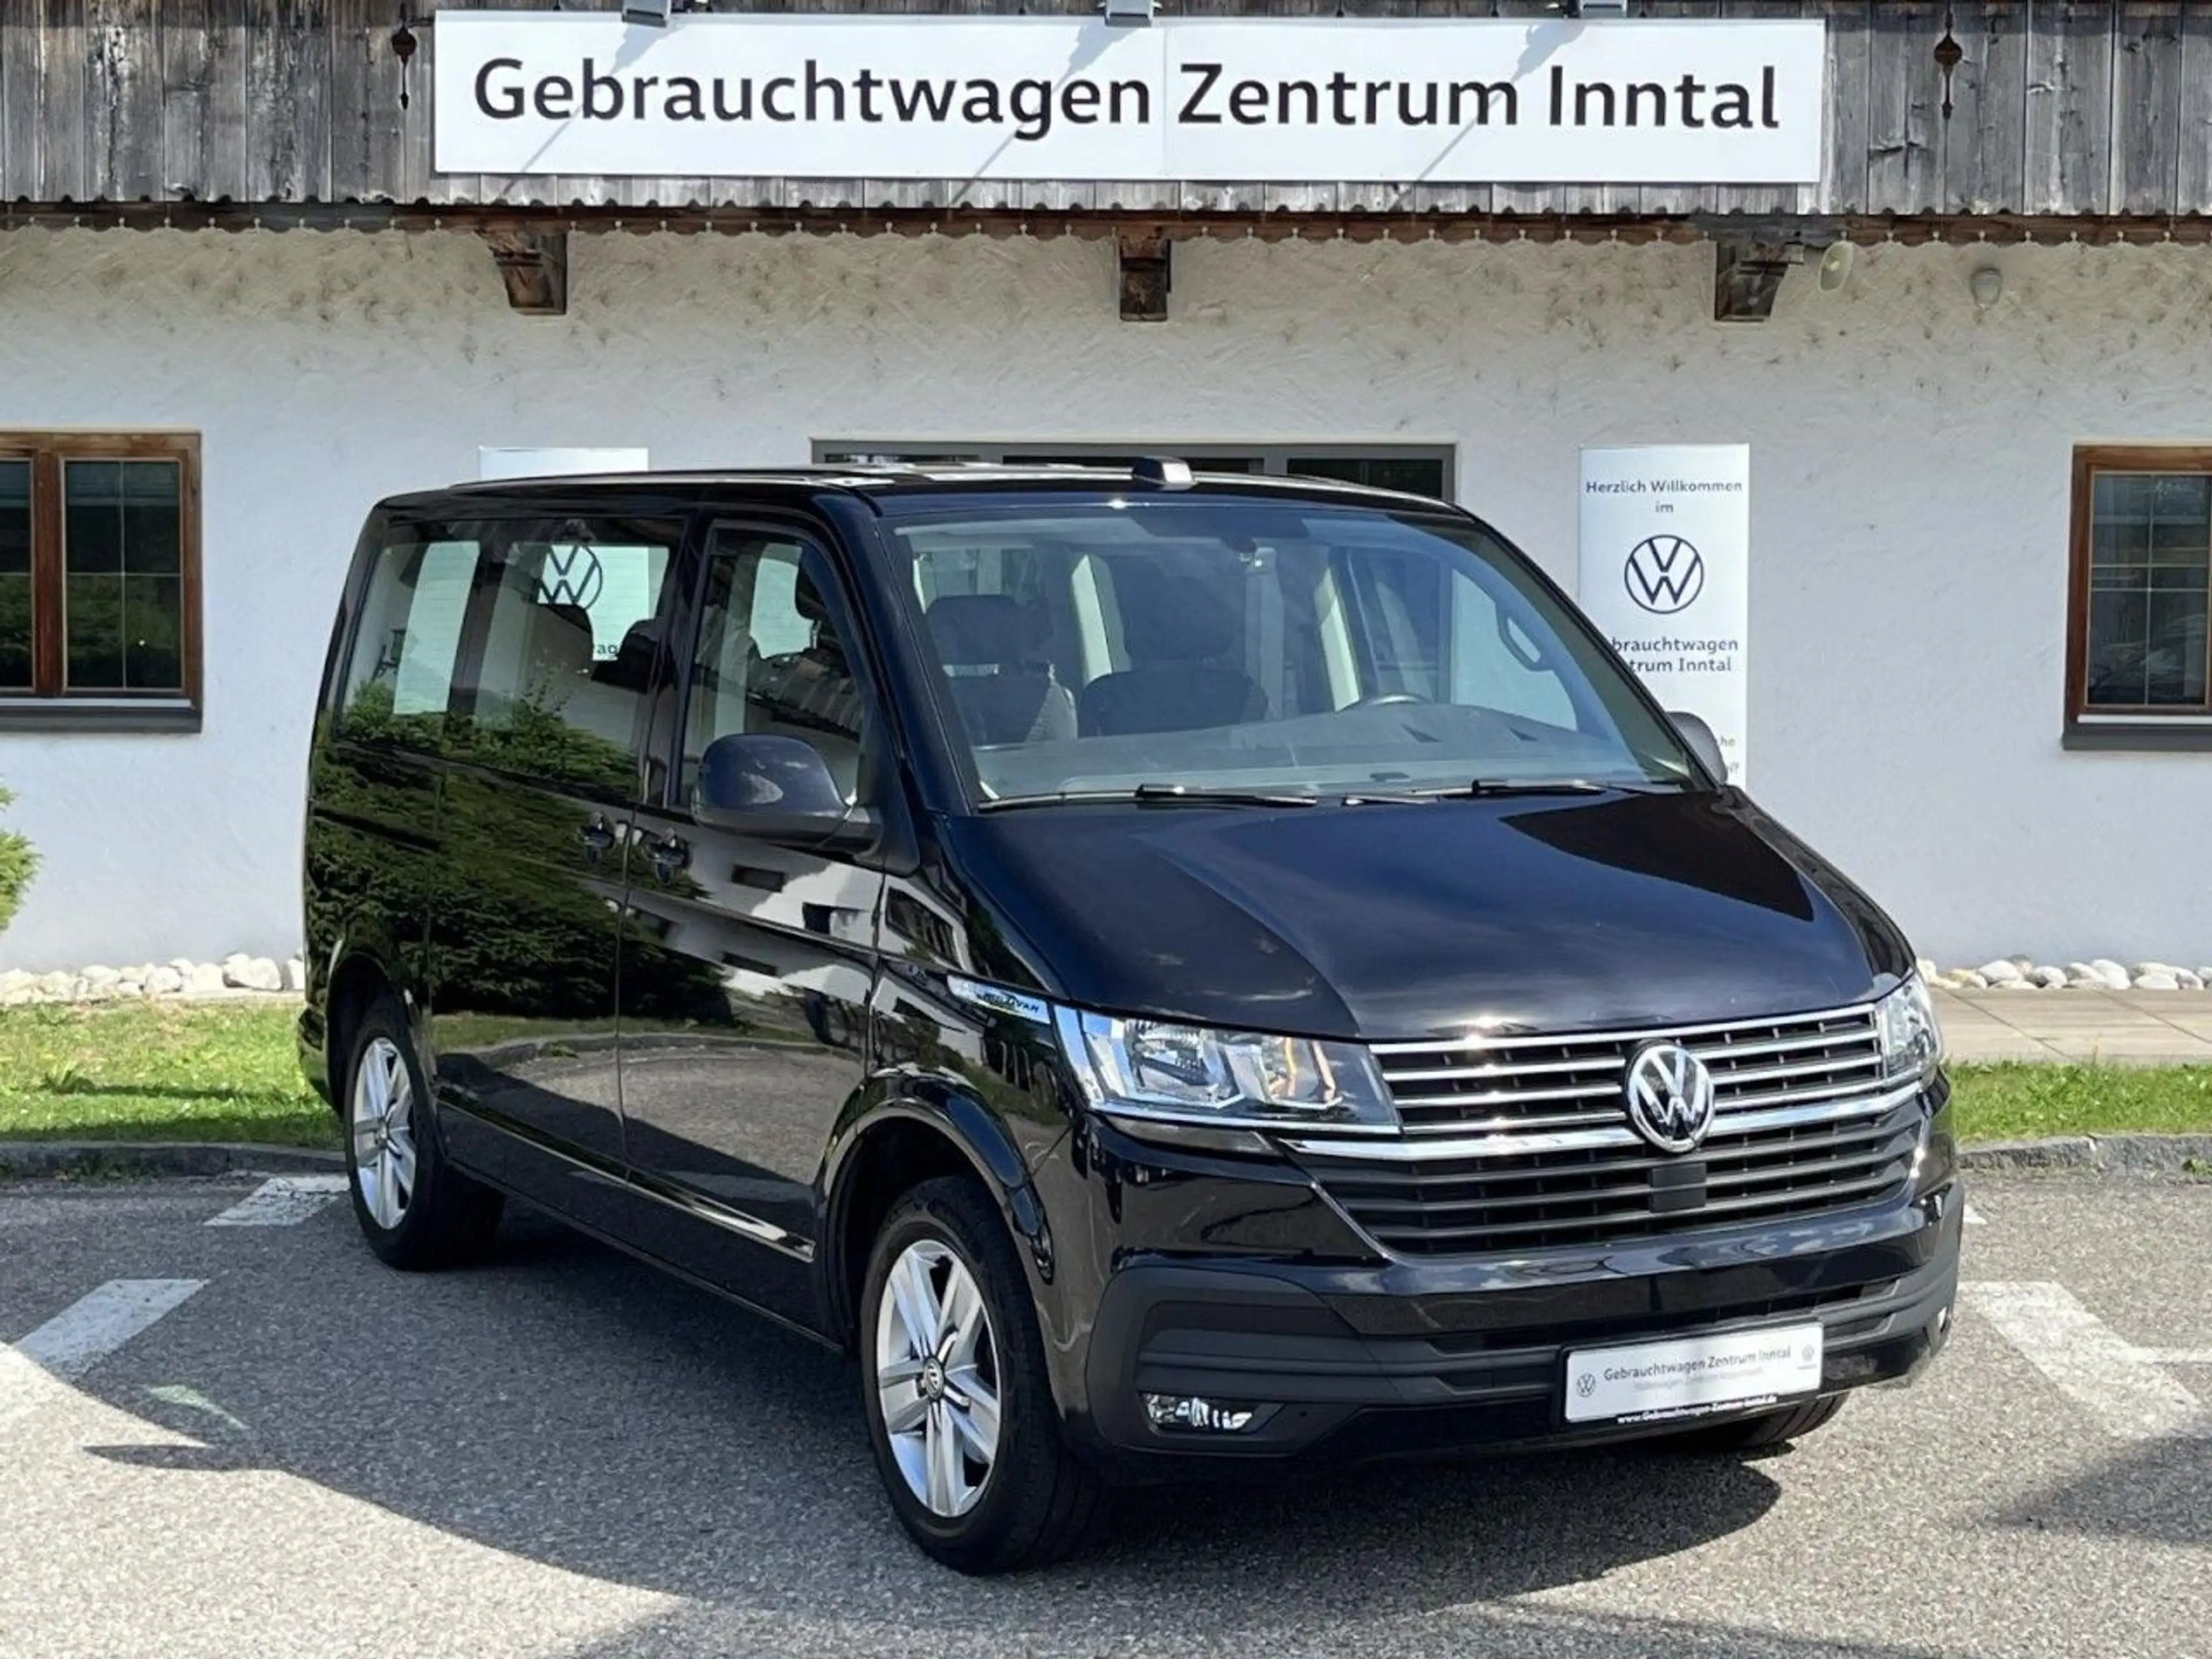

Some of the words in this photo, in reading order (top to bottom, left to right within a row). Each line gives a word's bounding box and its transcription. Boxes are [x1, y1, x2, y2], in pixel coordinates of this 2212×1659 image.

[476, 58, 1149, 141] Gebrauchtwagen
[1178, 63, 1517, 125] Zentrum
[1550, 66, 1778, 128] Inntal
[1586, 480, 1646, 493] Herzlich
[1650, 480, 1742, 493] Willkommen
[1655, 501, 1674, 513] im
[1613, 636, 1738, 654] brauchtwagen
[1677, 657, 1732, 672] Inntal
[1604, 1359, 1706, 1381] Gebrauchtwagen
